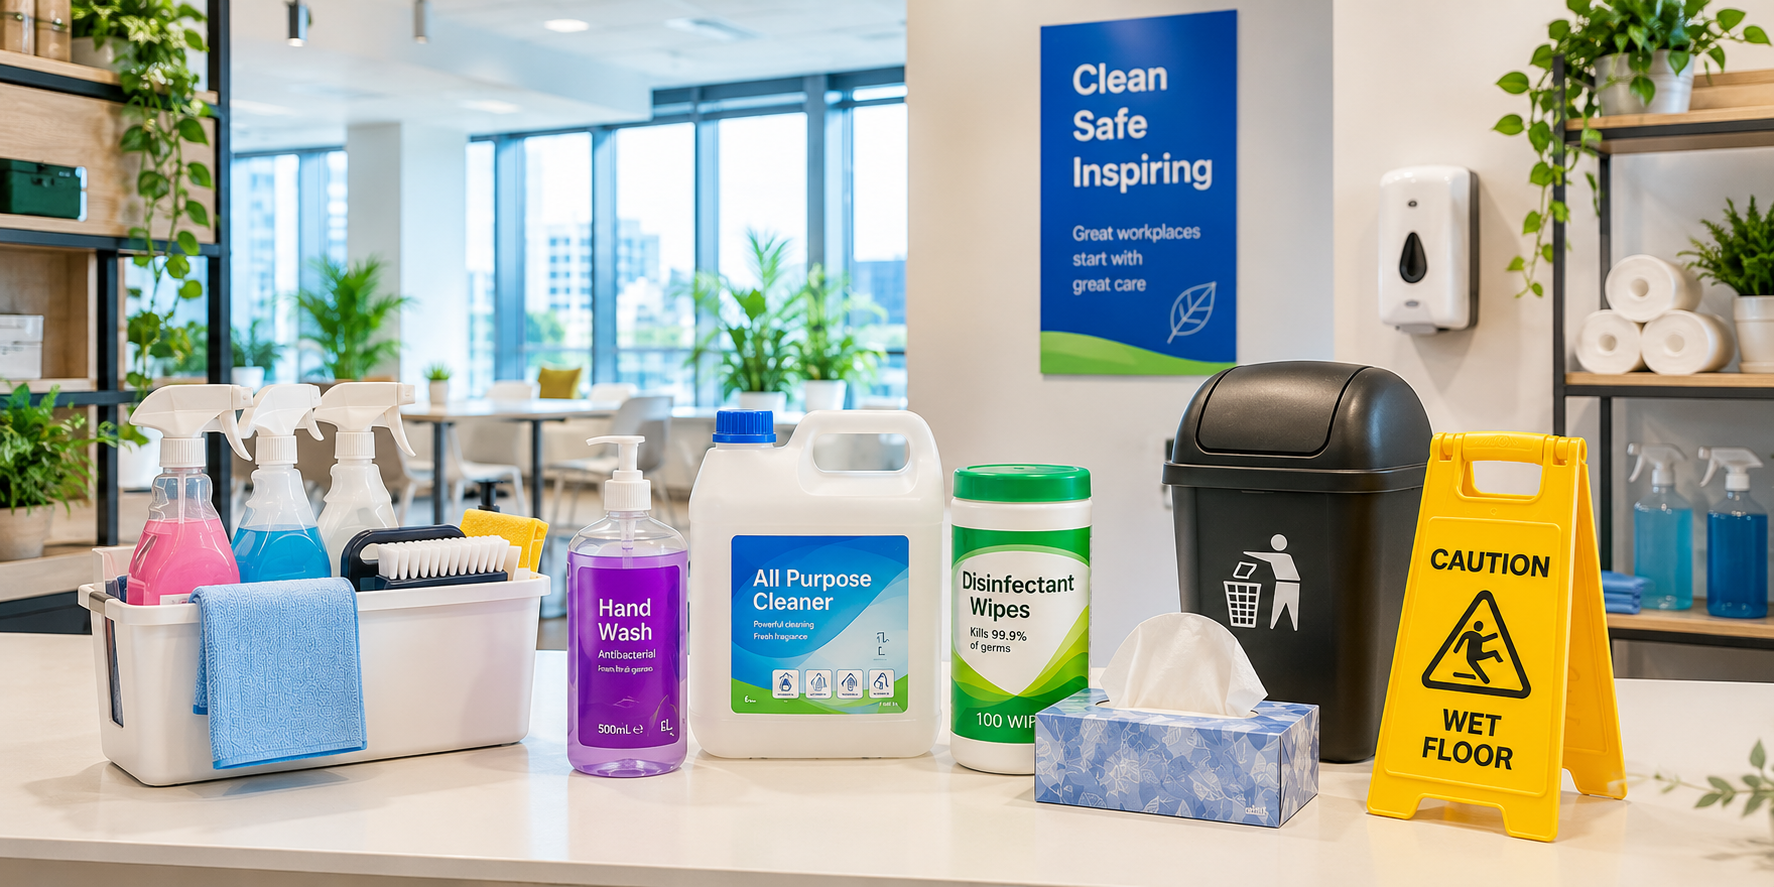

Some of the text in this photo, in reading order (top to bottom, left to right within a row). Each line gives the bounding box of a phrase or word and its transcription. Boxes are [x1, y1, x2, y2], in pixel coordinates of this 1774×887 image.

[1072, 62, 1167, 95] Clean
[1072, 106, 1148, 142] Safe
[1073, 152, 1213, 194] Inspiring
[1072, 223, 1201, 243] Great workplaces
[1072, 250, 1143, 267] start with
[1072, 277, 1147, 296] great care
[1430, 548, 1550, 578] CAUTION
[753, 569, 872, 592] All Purpose
[962, 571, 1075, 594] Disinfectant
[599, 598, 651, 617] Hand
[753, 592, 834, 611] Cleaner
[970, 597, 1030, 621] Wipes
[598, 622, 652, 641] Wash
[753, 620, 783, 628] Powerful
[970, 627, 1027, 641] Kills 99.9%
[598, 649, 656, 660] Antibacterial
[970, 641, 1011, 653] of germs
[598, 723, 632, 735] 500mL
[976, 712, 1036, 729] 100 WIP
[1443, 708, 1502, 737] WET
[1422, 736, 1513, 770] FLOOR
